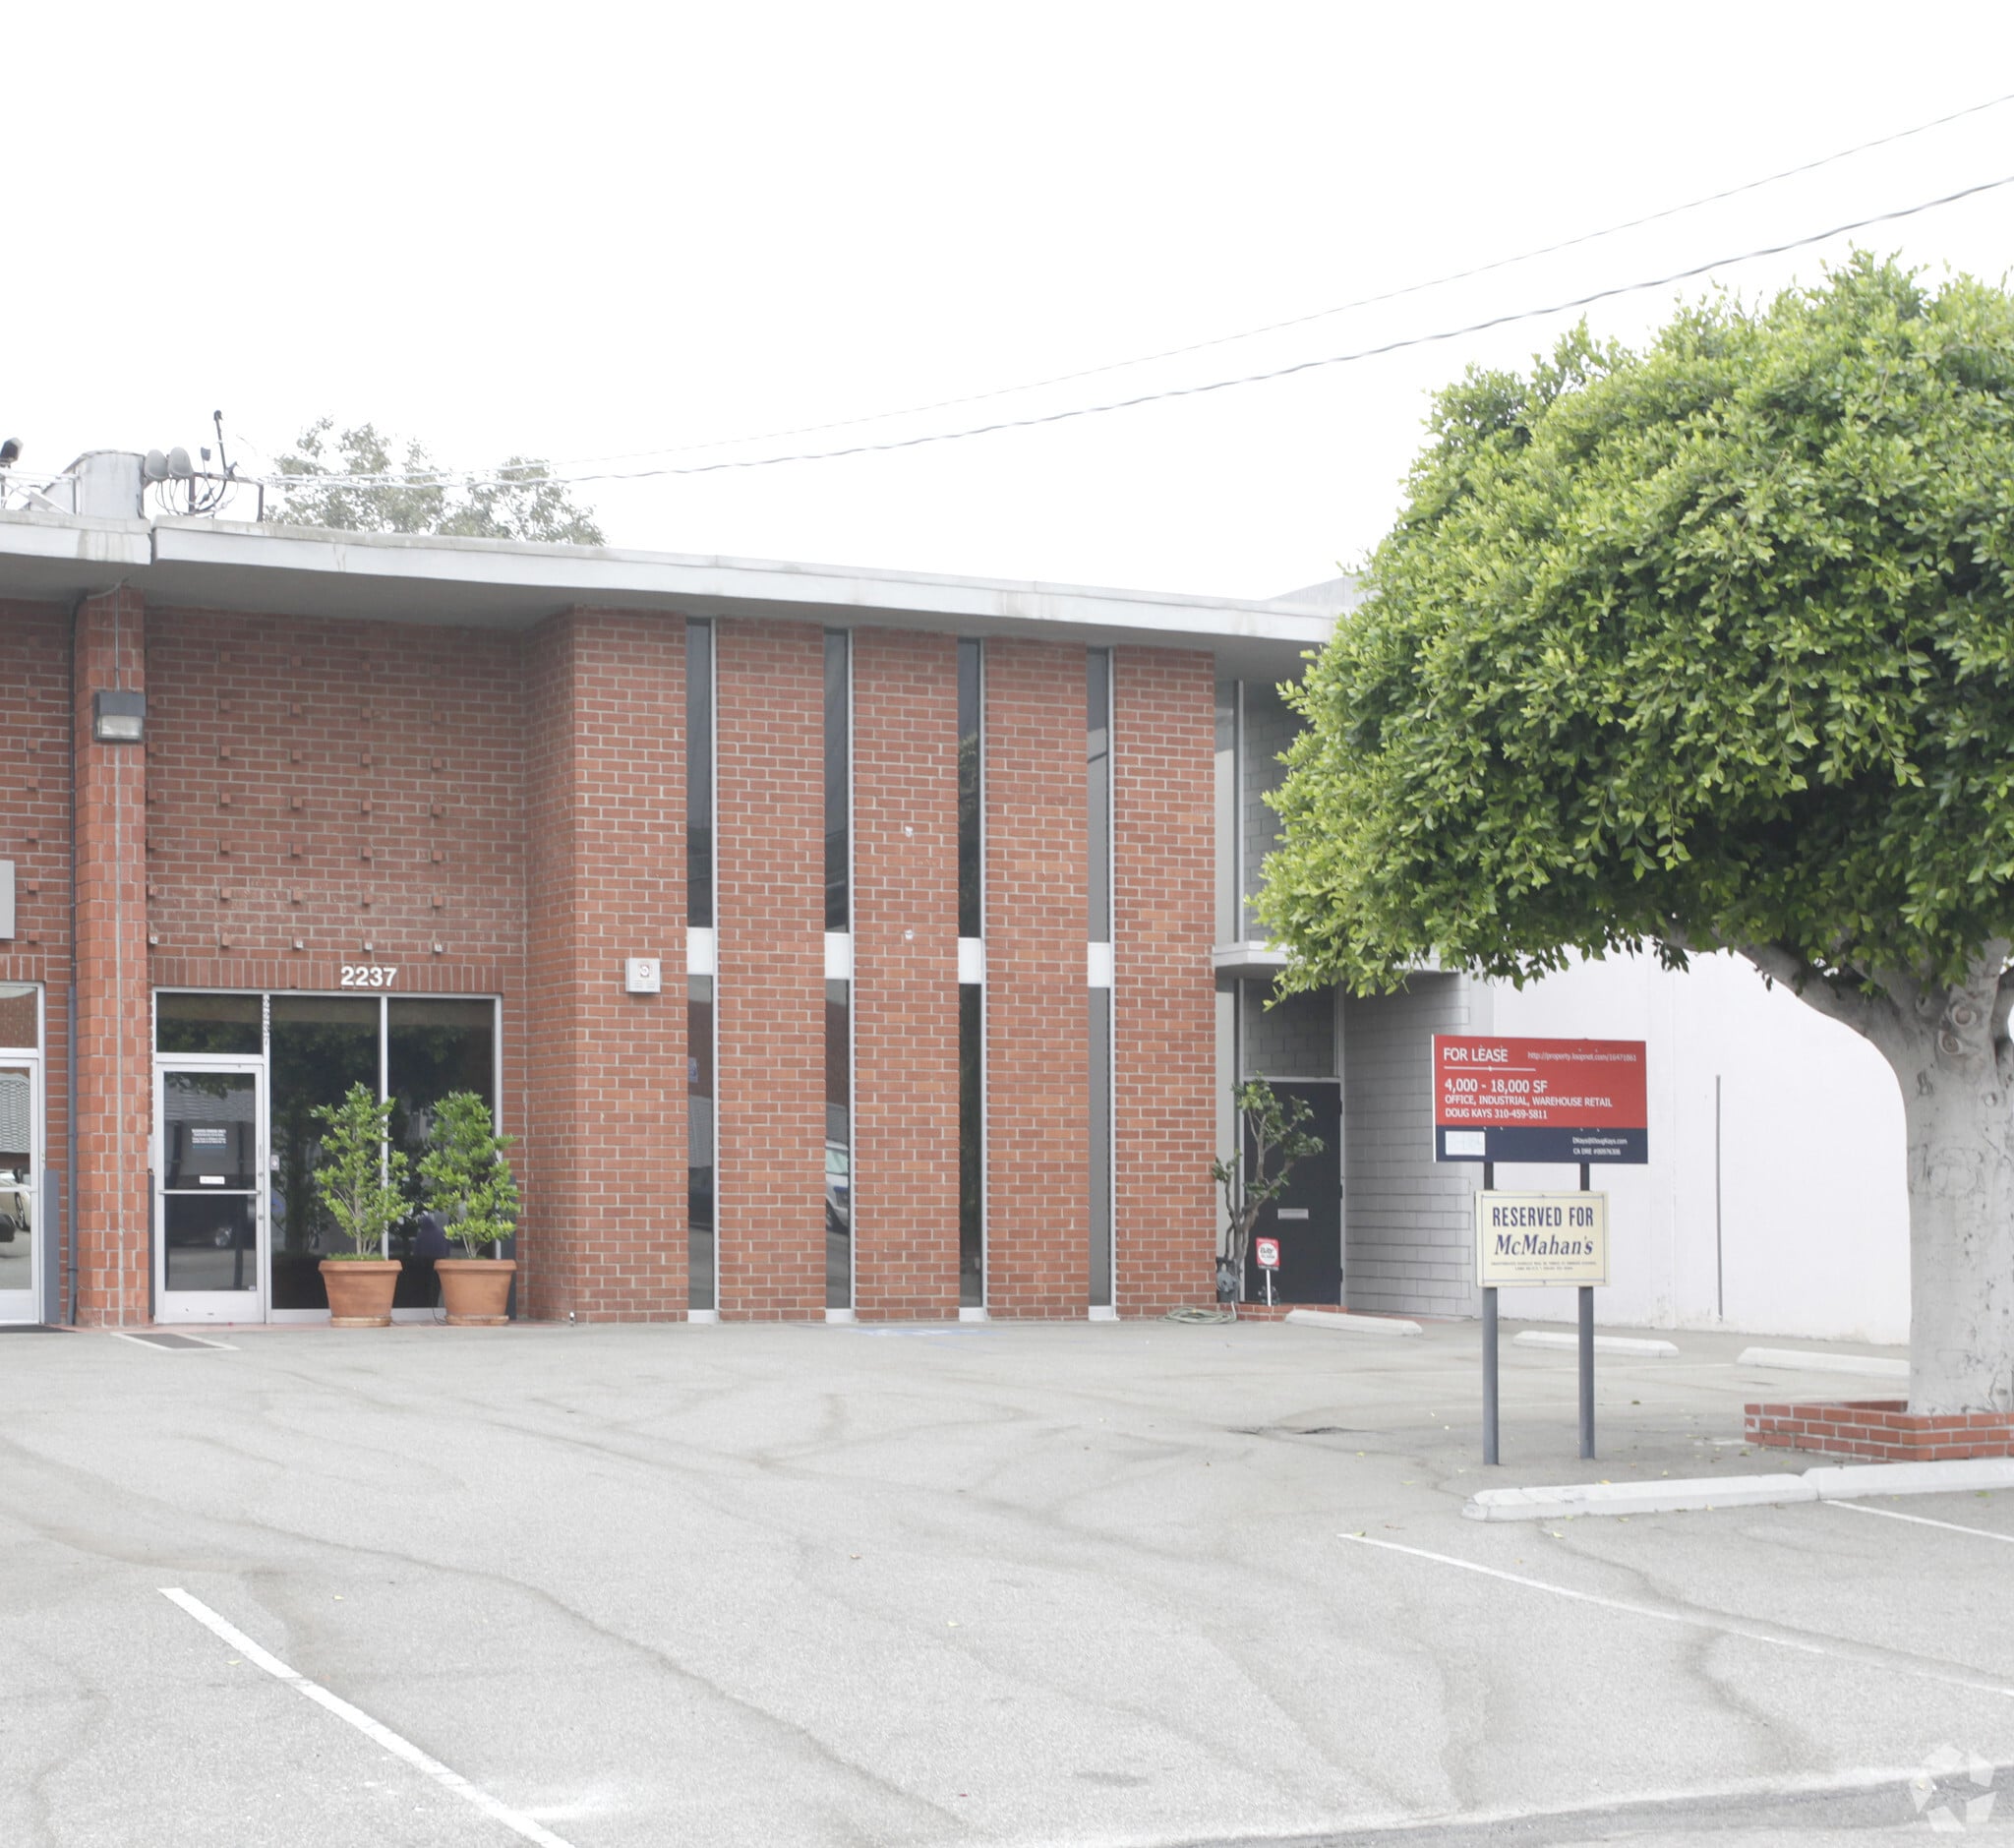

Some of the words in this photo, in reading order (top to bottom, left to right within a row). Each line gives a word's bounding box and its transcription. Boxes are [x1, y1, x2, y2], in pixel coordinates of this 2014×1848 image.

[340, 966, 397, 986] 2237
[1444, 1046, 1468, 1061] FOR
[1471, 1047, 1509, 1062] LEASE
[1445, 1078, 1478, 1094] 4,000
[1491, 1079, 1530, 1095] 18,000
[1533, 1080, 1548, 1094] SF
[1445, 1095, 1477, 1105] OFFICE,
[1479, 1096, 1530, 1106] INDUSTRIAL,
[1532, 1096, 1583, 1106] WAREHOUSE
[1584, 1097, 1613, 1107] RETAIL
[1445, 1108, 1469, 1117] DOUG
[1471, 1108, 1493, 1118] KAYS
[1494, 1108, 1547, 1119] 310-459-5811
[1492, 1206, 1562, 1227] RESERVED
[1569, 1206, 1594, 1227] FOR
[1494, 1234, 1594, 1255] McMahan's
